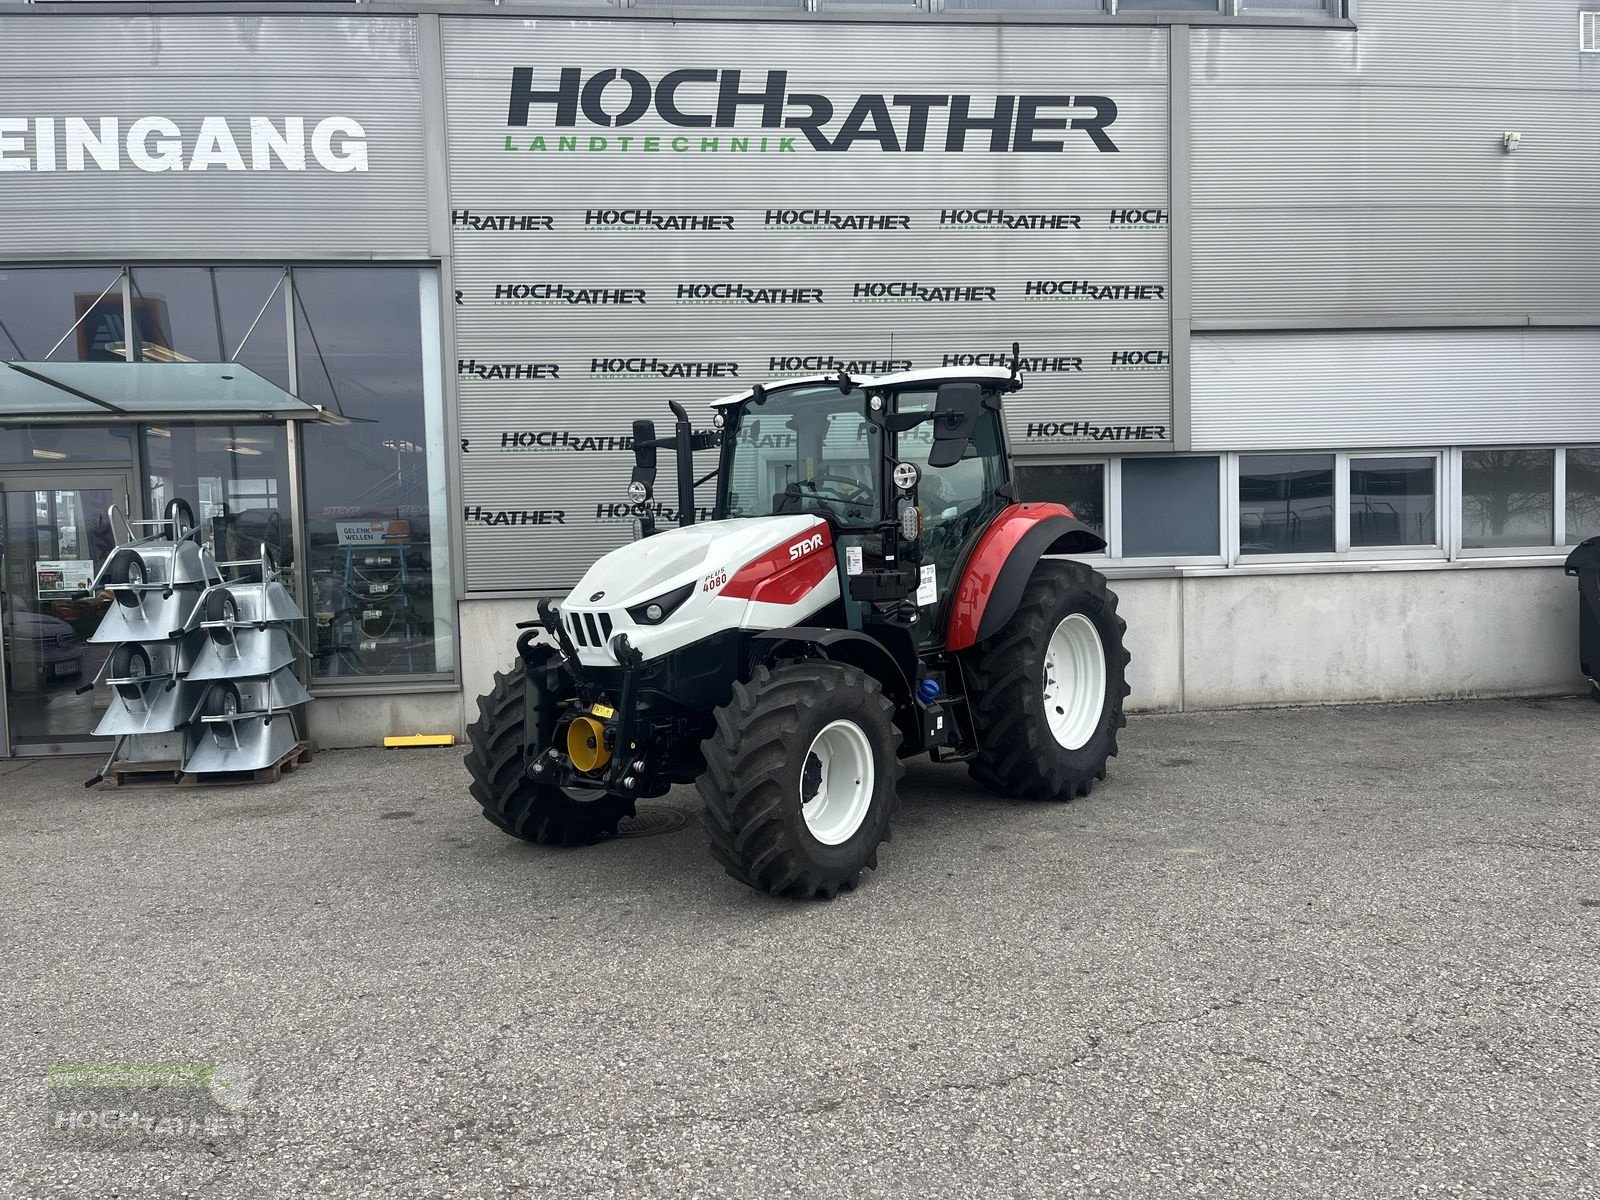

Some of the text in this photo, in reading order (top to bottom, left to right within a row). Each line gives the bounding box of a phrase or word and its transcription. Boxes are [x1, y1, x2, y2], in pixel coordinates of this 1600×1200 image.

[507, 67, 1120, 152] HOCHRATHER
[0, 116, 369, 172] EINGANG
[504, 136, 796, 152] LANDTECHNIK
[585, 210, 735, 230] HOCHRATHER
[765, 210, 911, 229] HOCHRATHER
[940, 209, 1081, 229] HOCHRATHER
[495, 284, 647, 304] HOCHRATHER
[677, 284, 824, 304] HOCHRATHER
[853, 282, 997, 302] HOCHRATHER
[1025, 281, 1165, 300] HOCHRATHER
[591, 358, 739, 377] HOCHRATHER
[1027, 422, 1166, 440] HOCHRATHER
[789, 533, 823, 561] STEYR
[702, 573, 727, 592] 4080
[704, 566, 725, 583] PLUS
